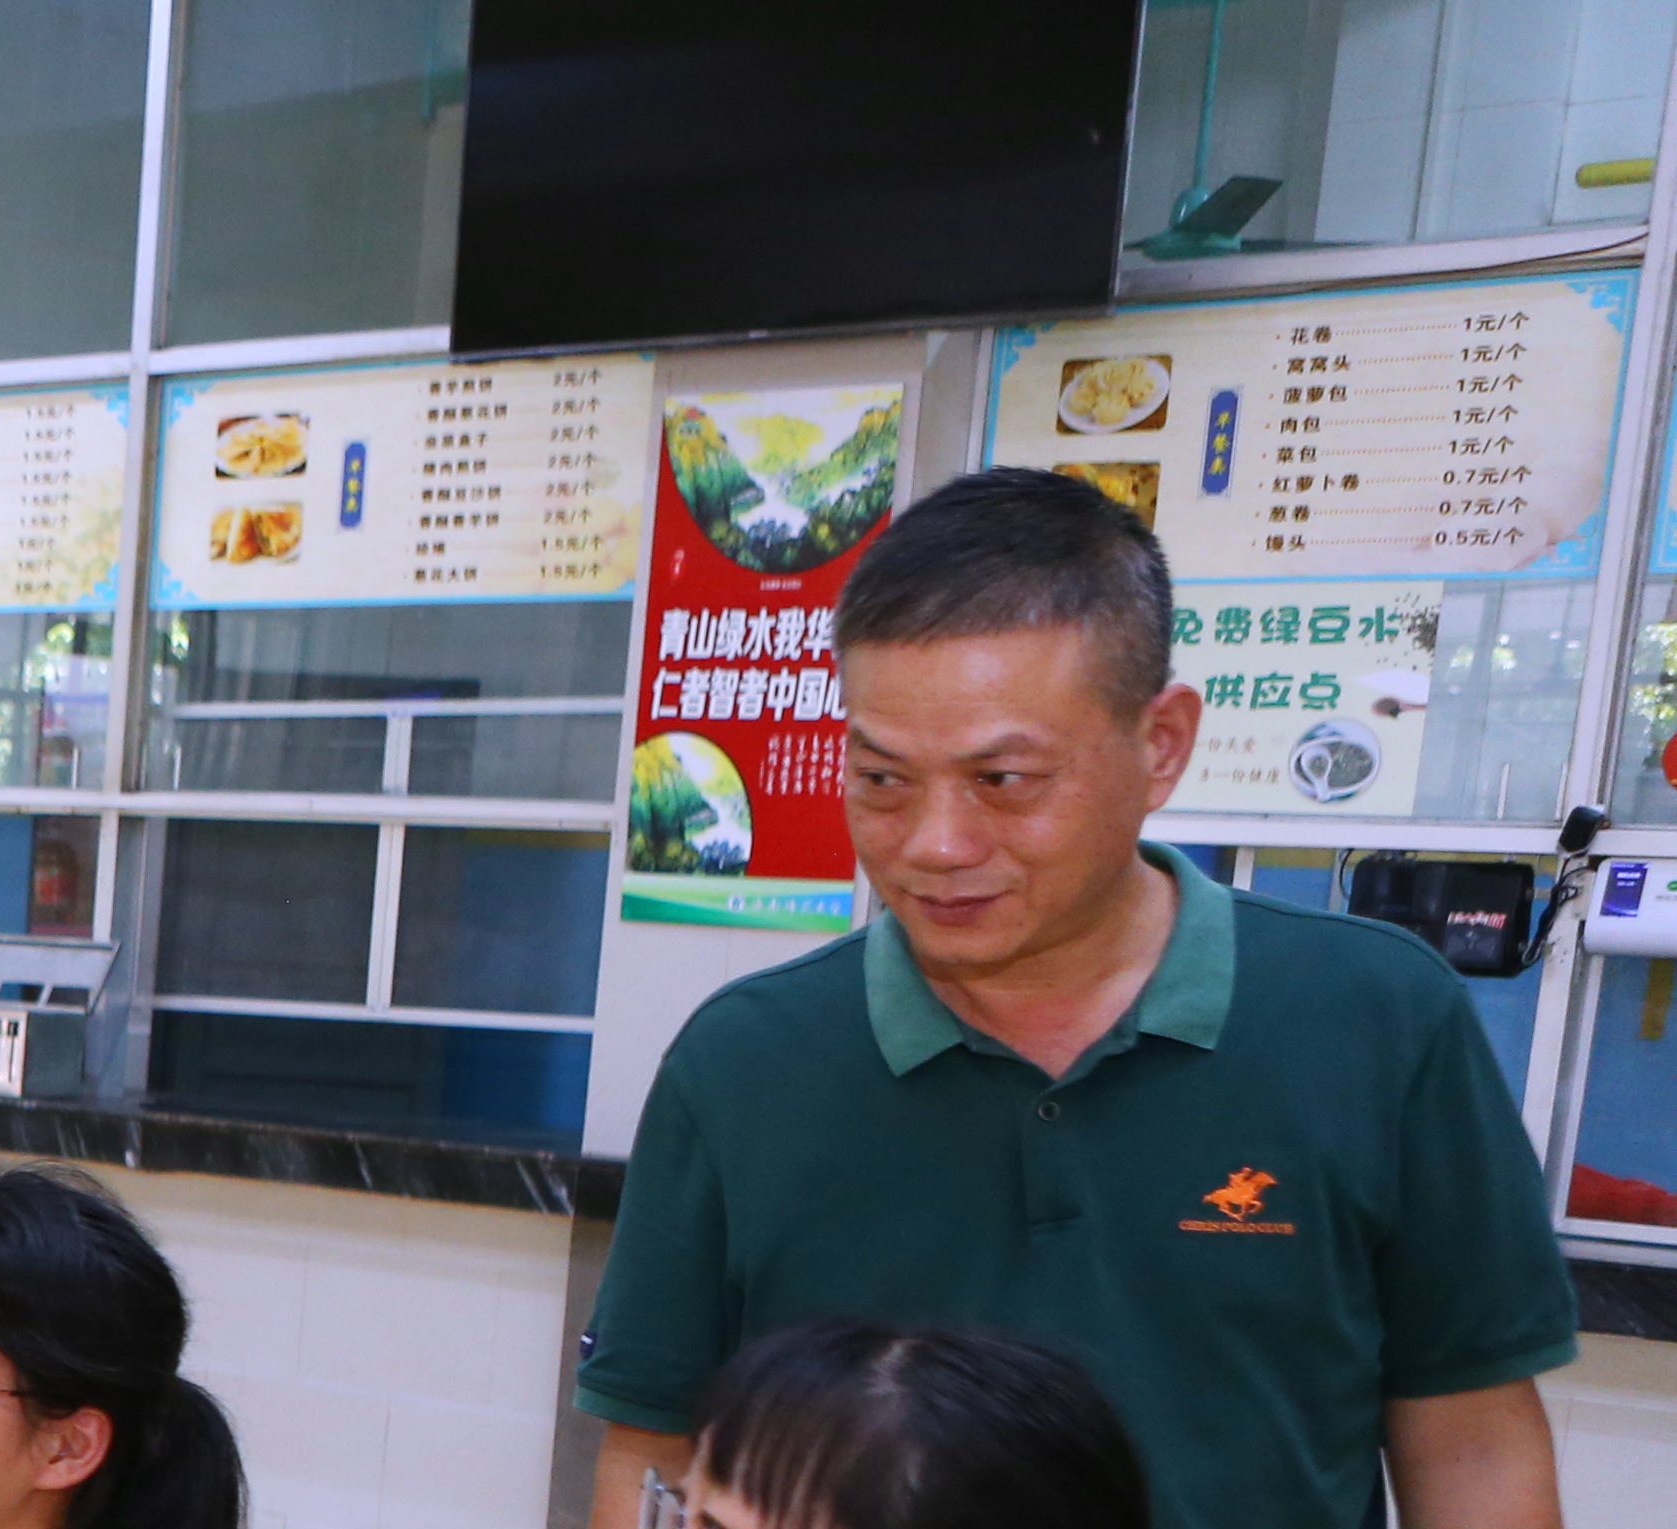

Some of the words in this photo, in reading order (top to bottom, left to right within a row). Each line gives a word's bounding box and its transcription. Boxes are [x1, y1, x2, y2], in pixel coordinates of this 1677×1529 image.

[1290, 326, 1332, 345] 花卷
[1462, 311, 1530, 332] 1元/个
[1286, 355, 1351, 375] 窝窝头
[1460, 343, 1527, 363] 1元/个
[1455, 374, 1523, 394] 1元/个
[1279, 416, 1321, 435] 肉包
[1451, 405, 1519, 424] 1元/个
[1276, 446, 1317, 464] 菜包
[1448, 435, 1515, 455] 1元/个
[1443, 465, 1532, 486] 0.7元/个
[1268, 505, 1311, 523] 葱卷
[1439, 496, 1528, 517] 0.7元/个
[1265, 534, 1307, 552] 馒头
[1435, 527, 1524, 547] 0.5元/个
[659, 606, 837, 662] 青山绿水我华
[1171, 605, 1399, 645] 免费绿豆水
[1204, 671, 1342, 711] 供应点
